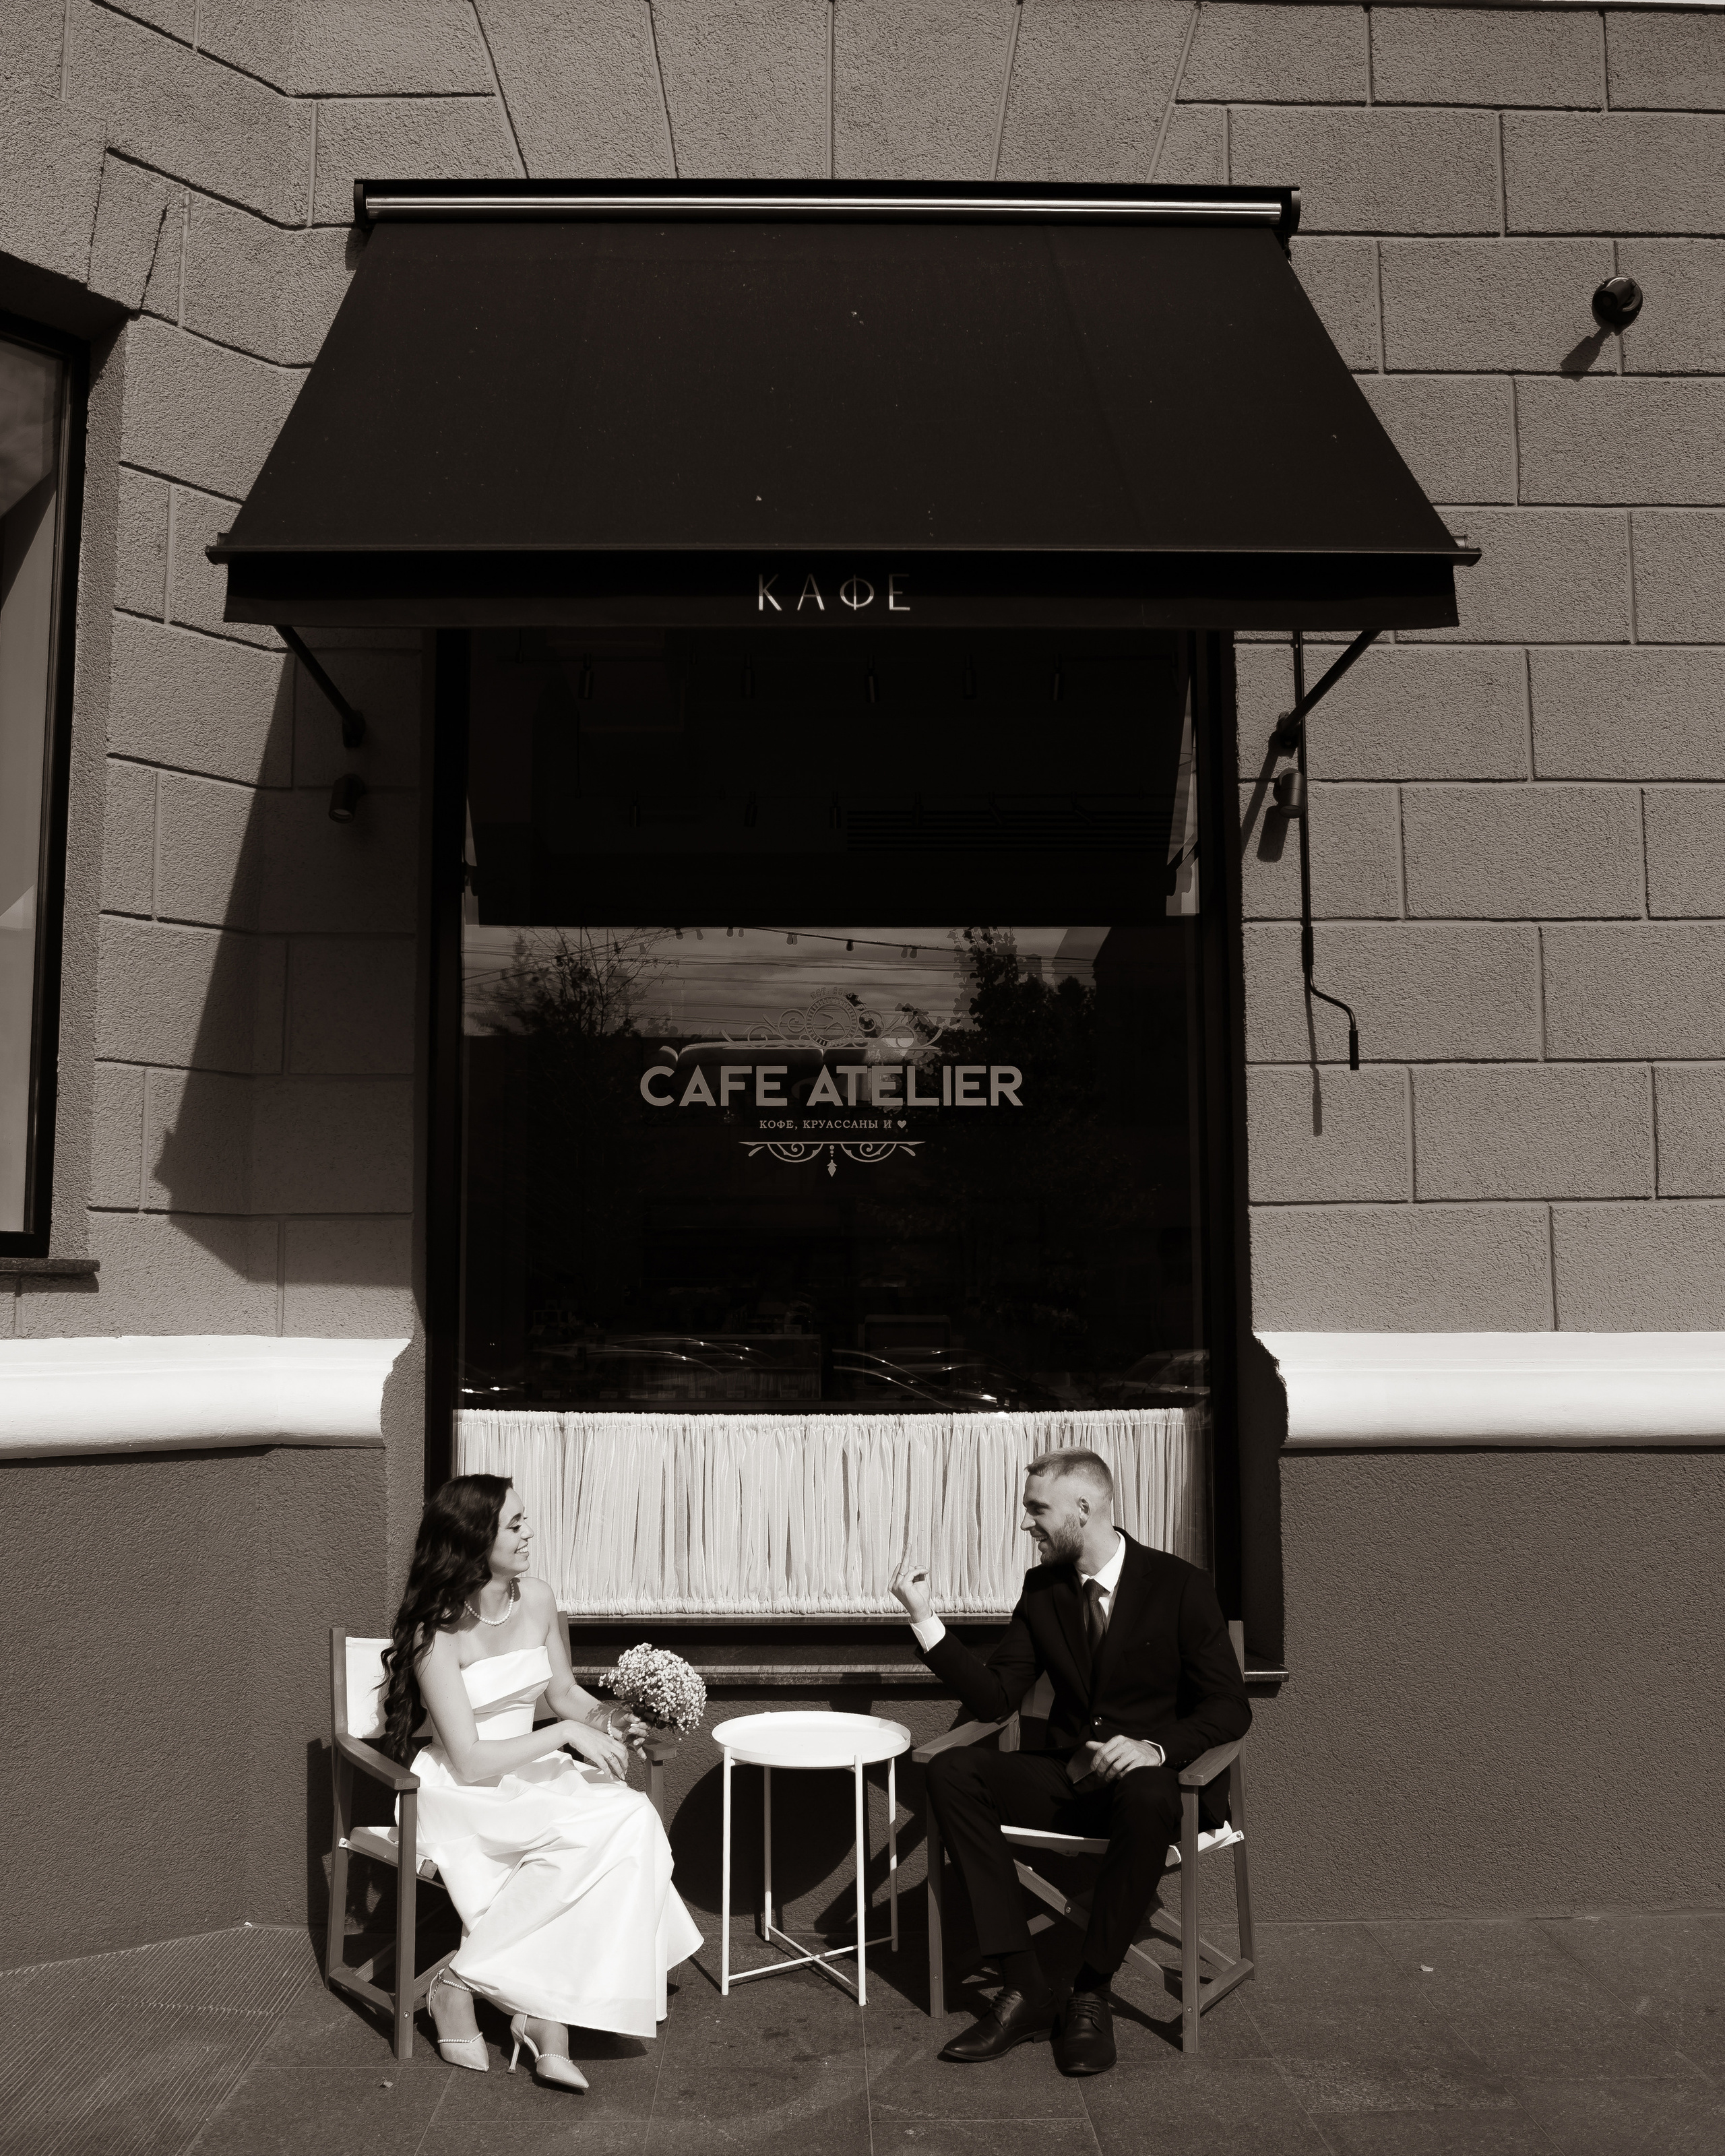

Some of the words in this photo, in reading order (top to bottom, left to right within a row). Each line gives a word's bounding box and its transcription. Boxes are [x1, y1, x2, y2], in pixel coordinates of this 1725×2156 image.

[758, 574, 911, 611] КАФЕ
[639, 1065, 788, 1106] CAFE
[806, 1065, 1024, 1106] ATELIER
[759, 1120, 798, 1130] КОФЕ,
[803, 1120, 879, 1129] КРУАССАНЫ
[883, 1120, 892, 1129] И
